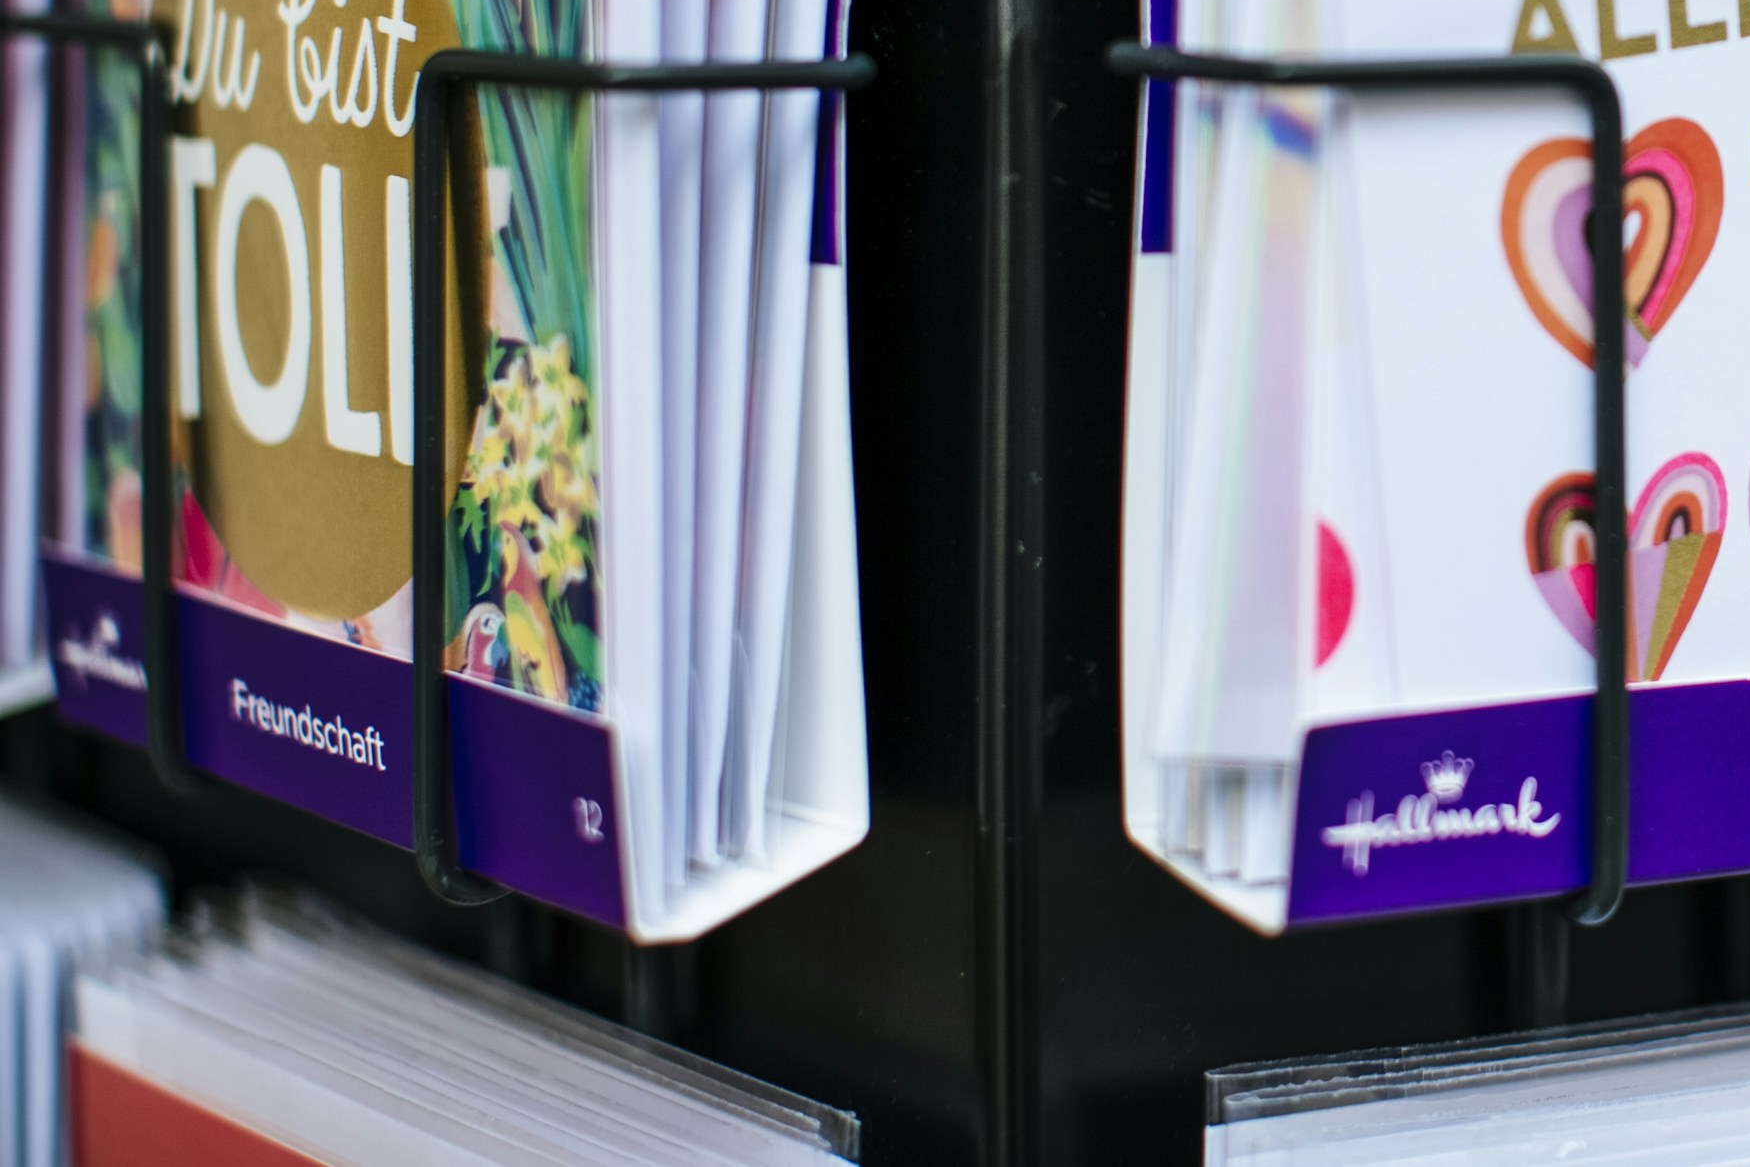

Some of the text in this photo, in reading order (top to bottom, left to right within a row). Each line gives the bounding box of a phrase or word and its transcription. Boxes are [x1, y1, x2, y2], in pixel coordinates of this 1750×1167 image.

[229, 677, 387, 772] Freundschaft
[572, 796, 605, 844] 12
[1321, 776, 1562, 878] Hallmark
